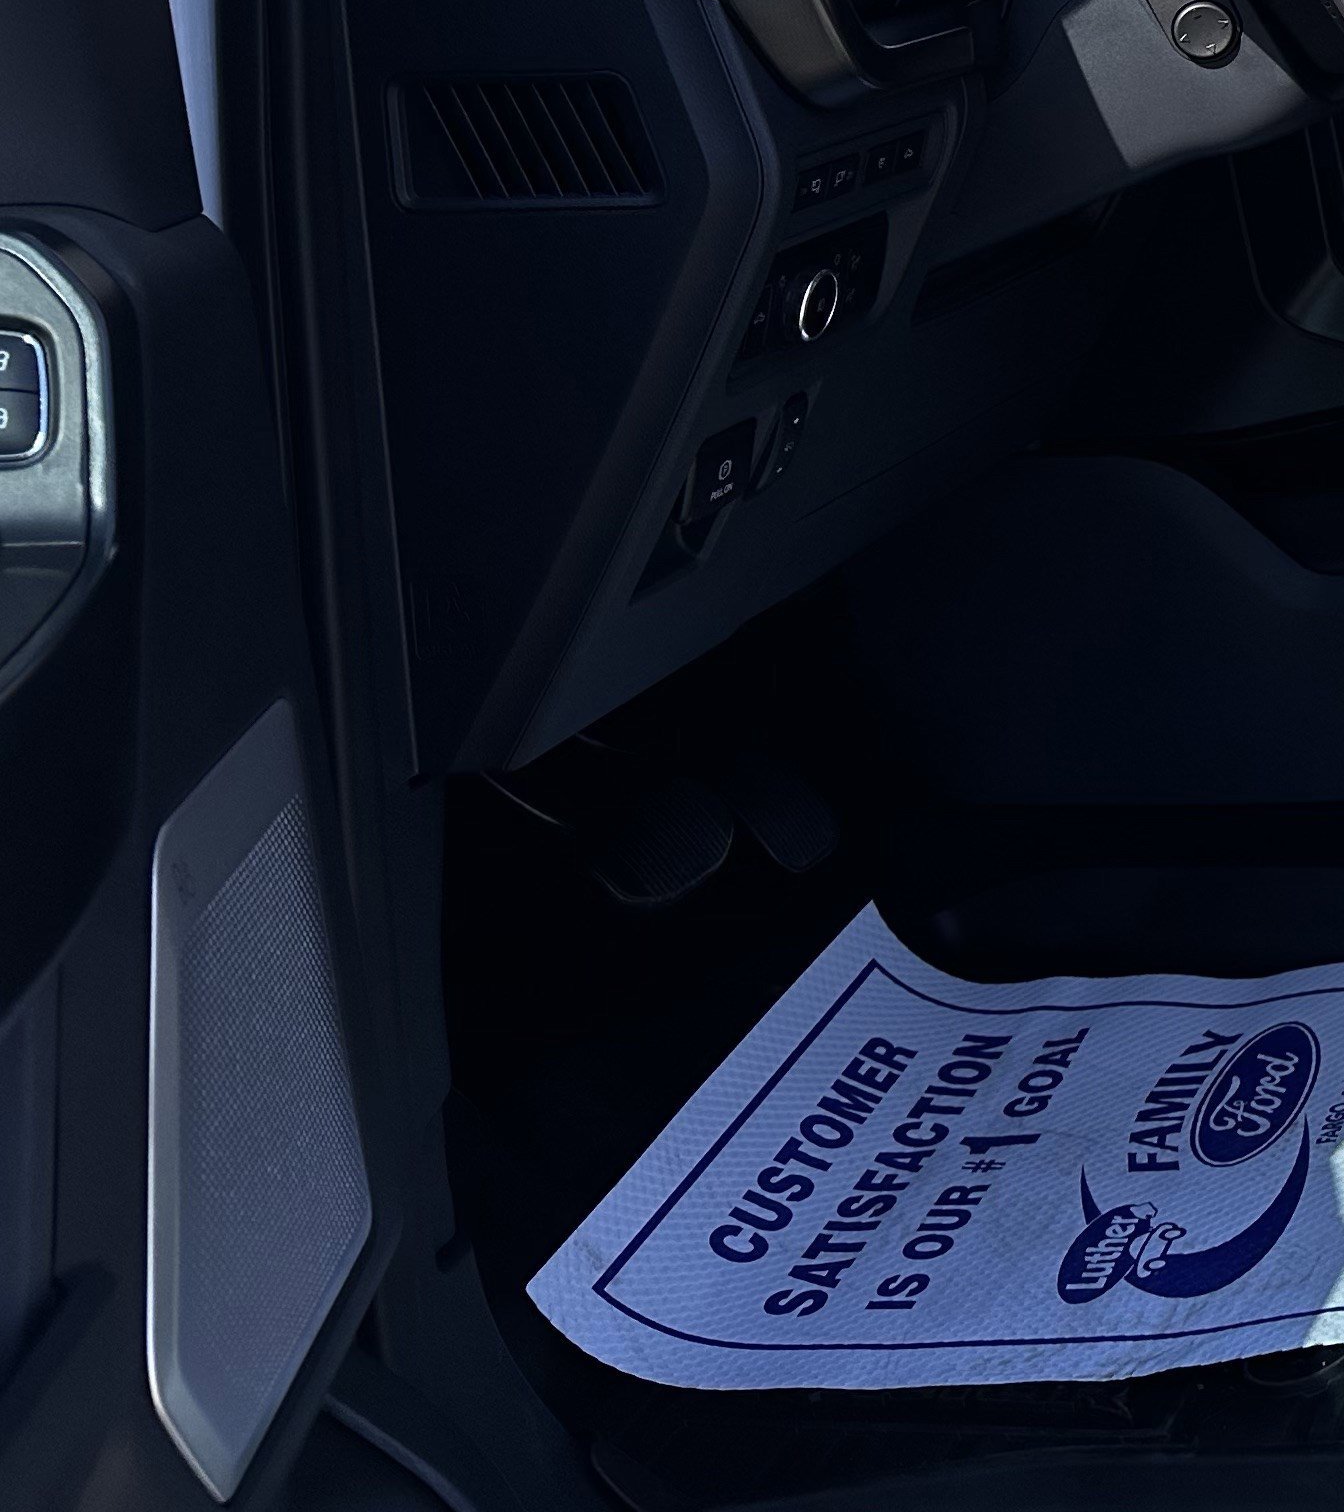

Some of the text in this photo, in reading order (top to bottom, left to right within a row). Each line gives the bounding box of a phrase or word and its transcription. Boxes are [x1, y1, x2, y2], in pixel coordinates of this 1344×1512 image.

[708, 1036, 919, 1264] CUSTOMER
[762, 1033, 1014, 1318] SATISFACTION
[864, 1026, 1091, 1311] IS OUR #1 GOAL
[1127, 1029, 1244, 1173] FAMILY
[1208, 1051, 1300, 1138] Ford
[1065, 1214, 1140, 1290] Luther
